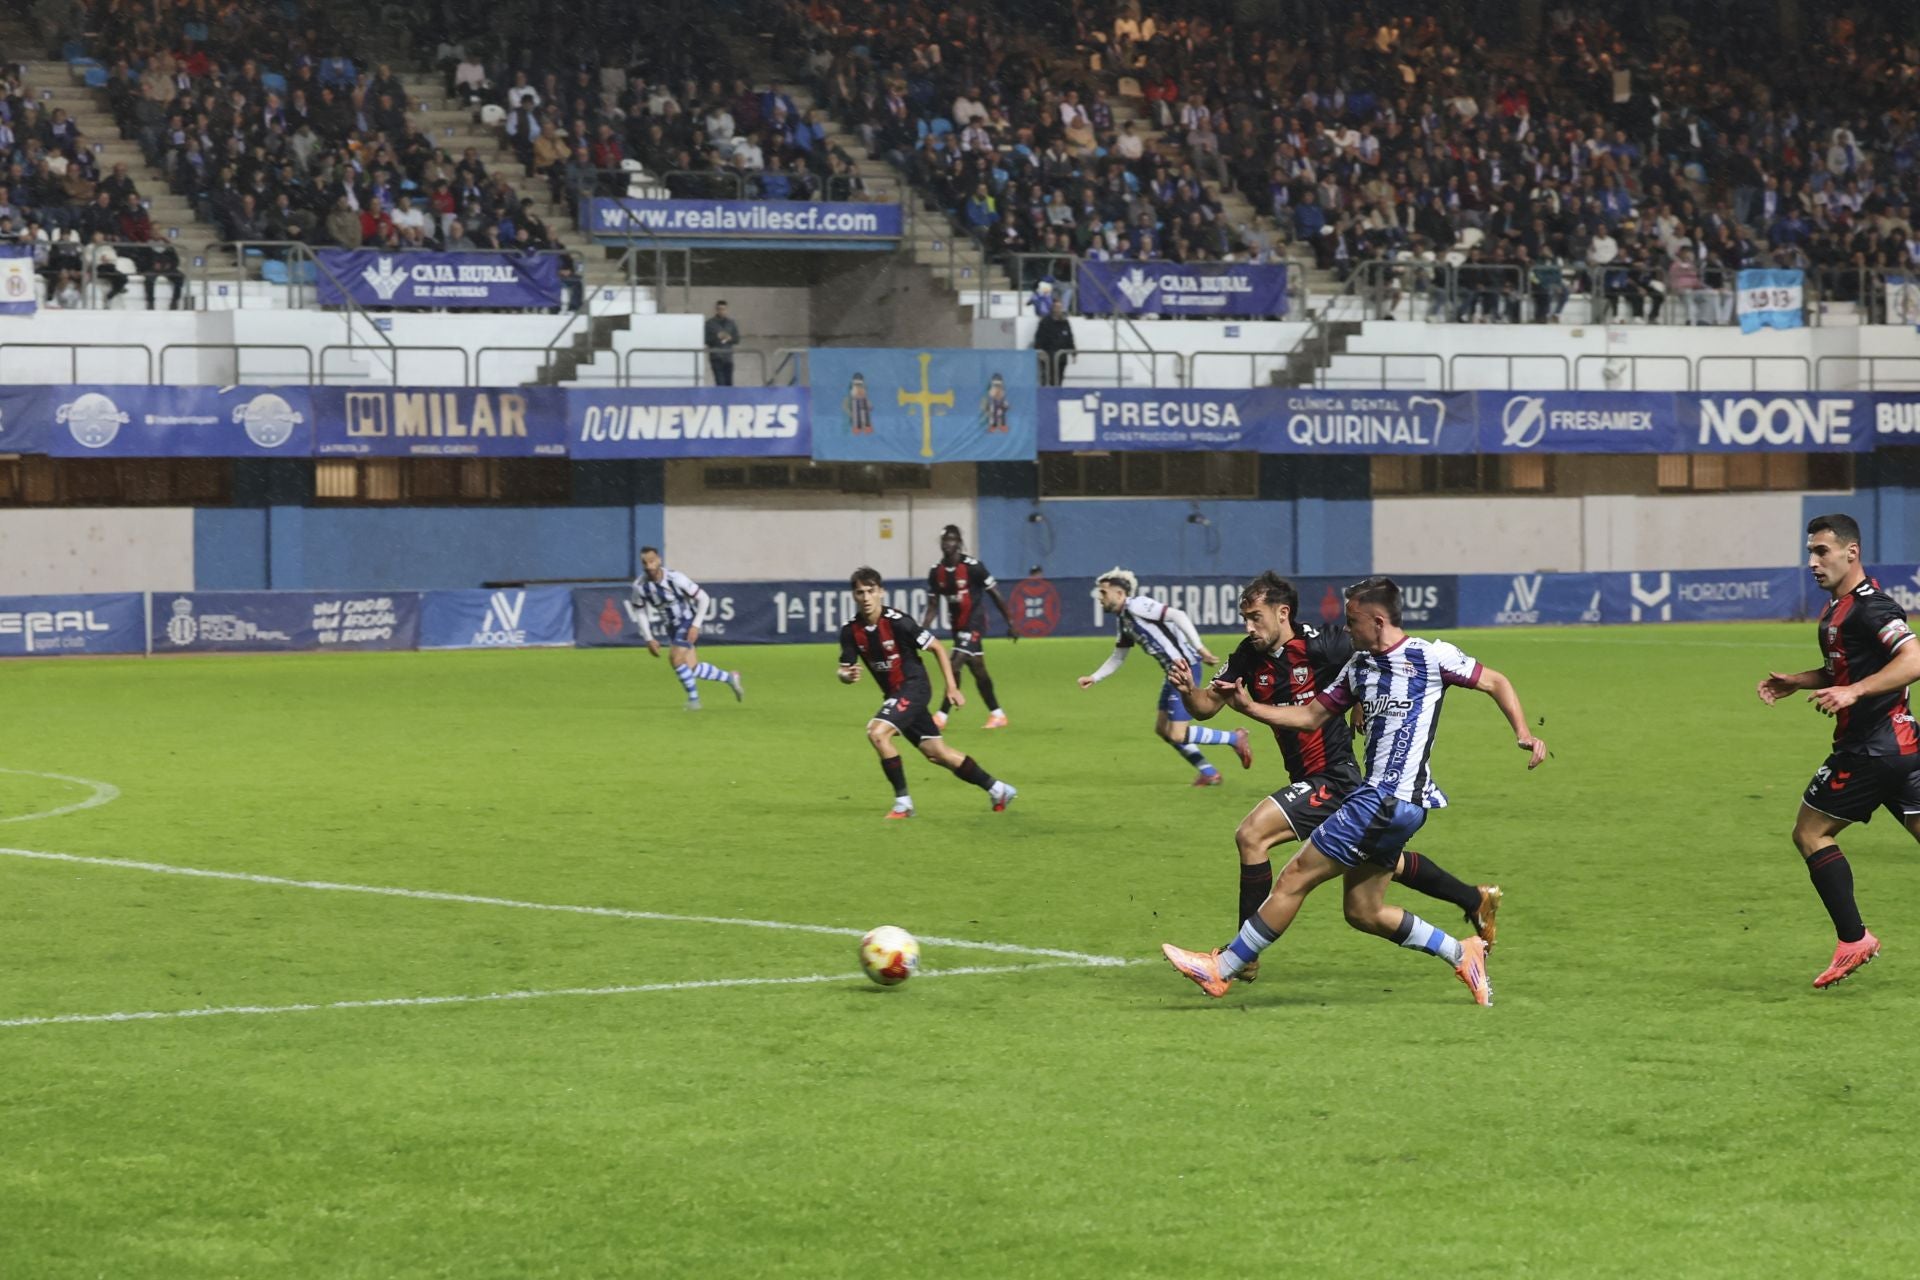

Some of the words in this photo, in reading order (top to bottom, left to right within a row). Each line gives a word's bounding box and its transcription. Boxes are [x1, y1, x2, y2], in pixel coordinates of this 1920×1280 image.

[601, 206, 878, 232] www.realavilescf.com
[411, 264, 456, 283] CAJA
[457, 264, 519, 283] RURAL
[1159, 274, 1198, 292] CAJA
[393, 393, 529, 437] MILAR
[626, 404, 799, 440] NEVARES
[1101, 401, 1242, 427] PRECUSA
[1550, 411, 1653, 431] FRESAMEX
[1698, 398, 1854, 445] NOONE
[1287, 413, 1430, 446] QUIRINAL
[1677, 580, 1771, 602] HORIZONTE
